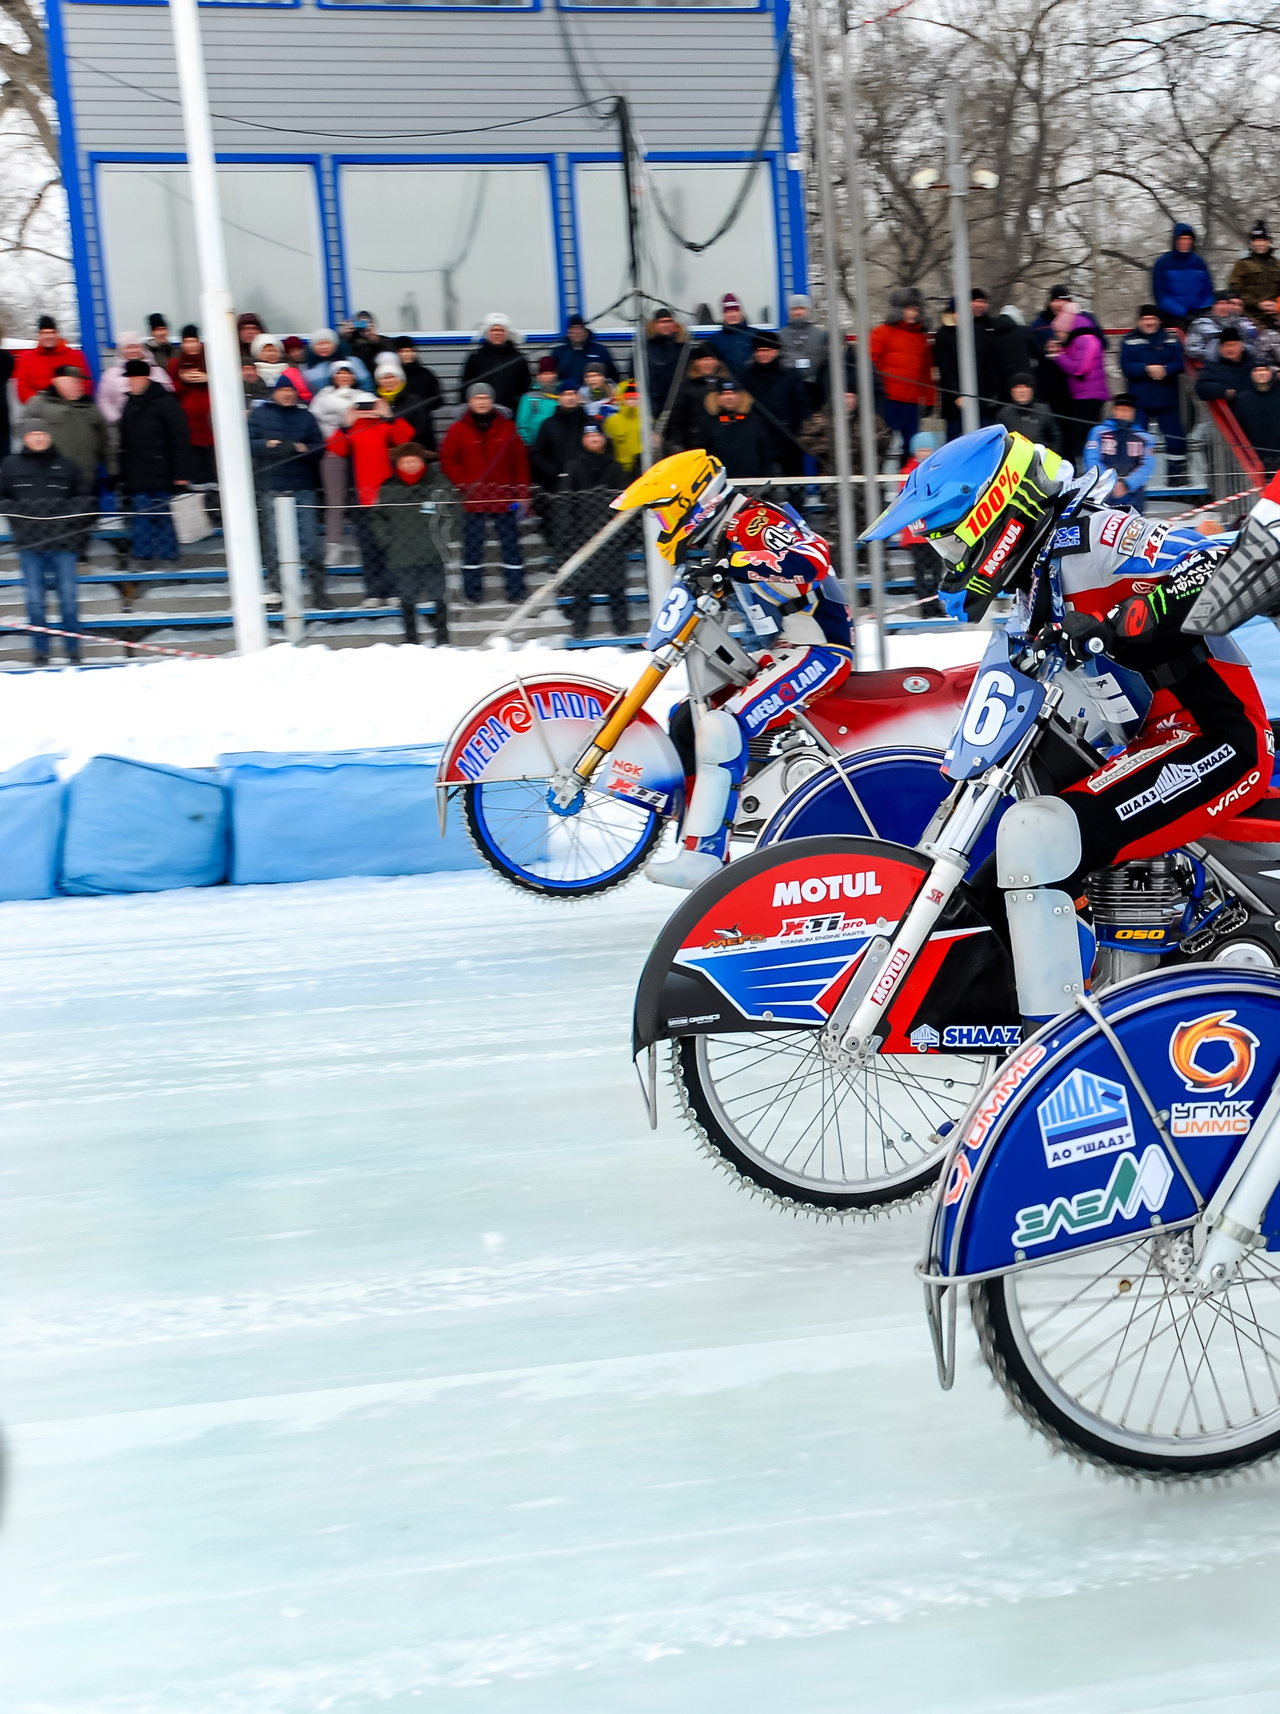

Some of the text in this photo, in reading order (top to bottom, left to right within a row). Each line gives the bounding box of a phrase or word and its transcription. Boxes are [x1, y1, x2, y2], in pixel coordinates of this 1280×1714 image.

[966, 465, 1020, 538] 100%
[983, 523, 1022, 576] MOTUL
[1166, 570, 1213, 595] MONST
[656, 587, 689, 632] 3
[745, 692, 785, 729] MEGA
[789, 659, 827, 694] LADA
[962, 669, 1016, 747] 6
[456, 692, 603, 782] MEGA LADA
[612, 759, 644, 777] NGK
[1196, 745, 1233, 774] SHAAZ
[1092, 760, 1136, 790] TITANIUM
[1119, 790, 1158, 818] ШААЗ
[1206, 770, 1262, 817] WACO
[772, 870, 882, 908] MOTUL
[702, 933, 765, 949] MEFO
[780, 930, 866, 946] TITANIUM ENGINE PARTS
[1115, 929, 1166, 940] OSO
[873, 949, 910, 1004] MOTUL
[943, 1025, 1022, 1047] SHAAZ
[1173, 1119, 1248, 1134] UMMC
[1174, 1104, 1248, 1120] УГМК
[1051, 1133, 1131, 1163] АО "ШААЗ"
